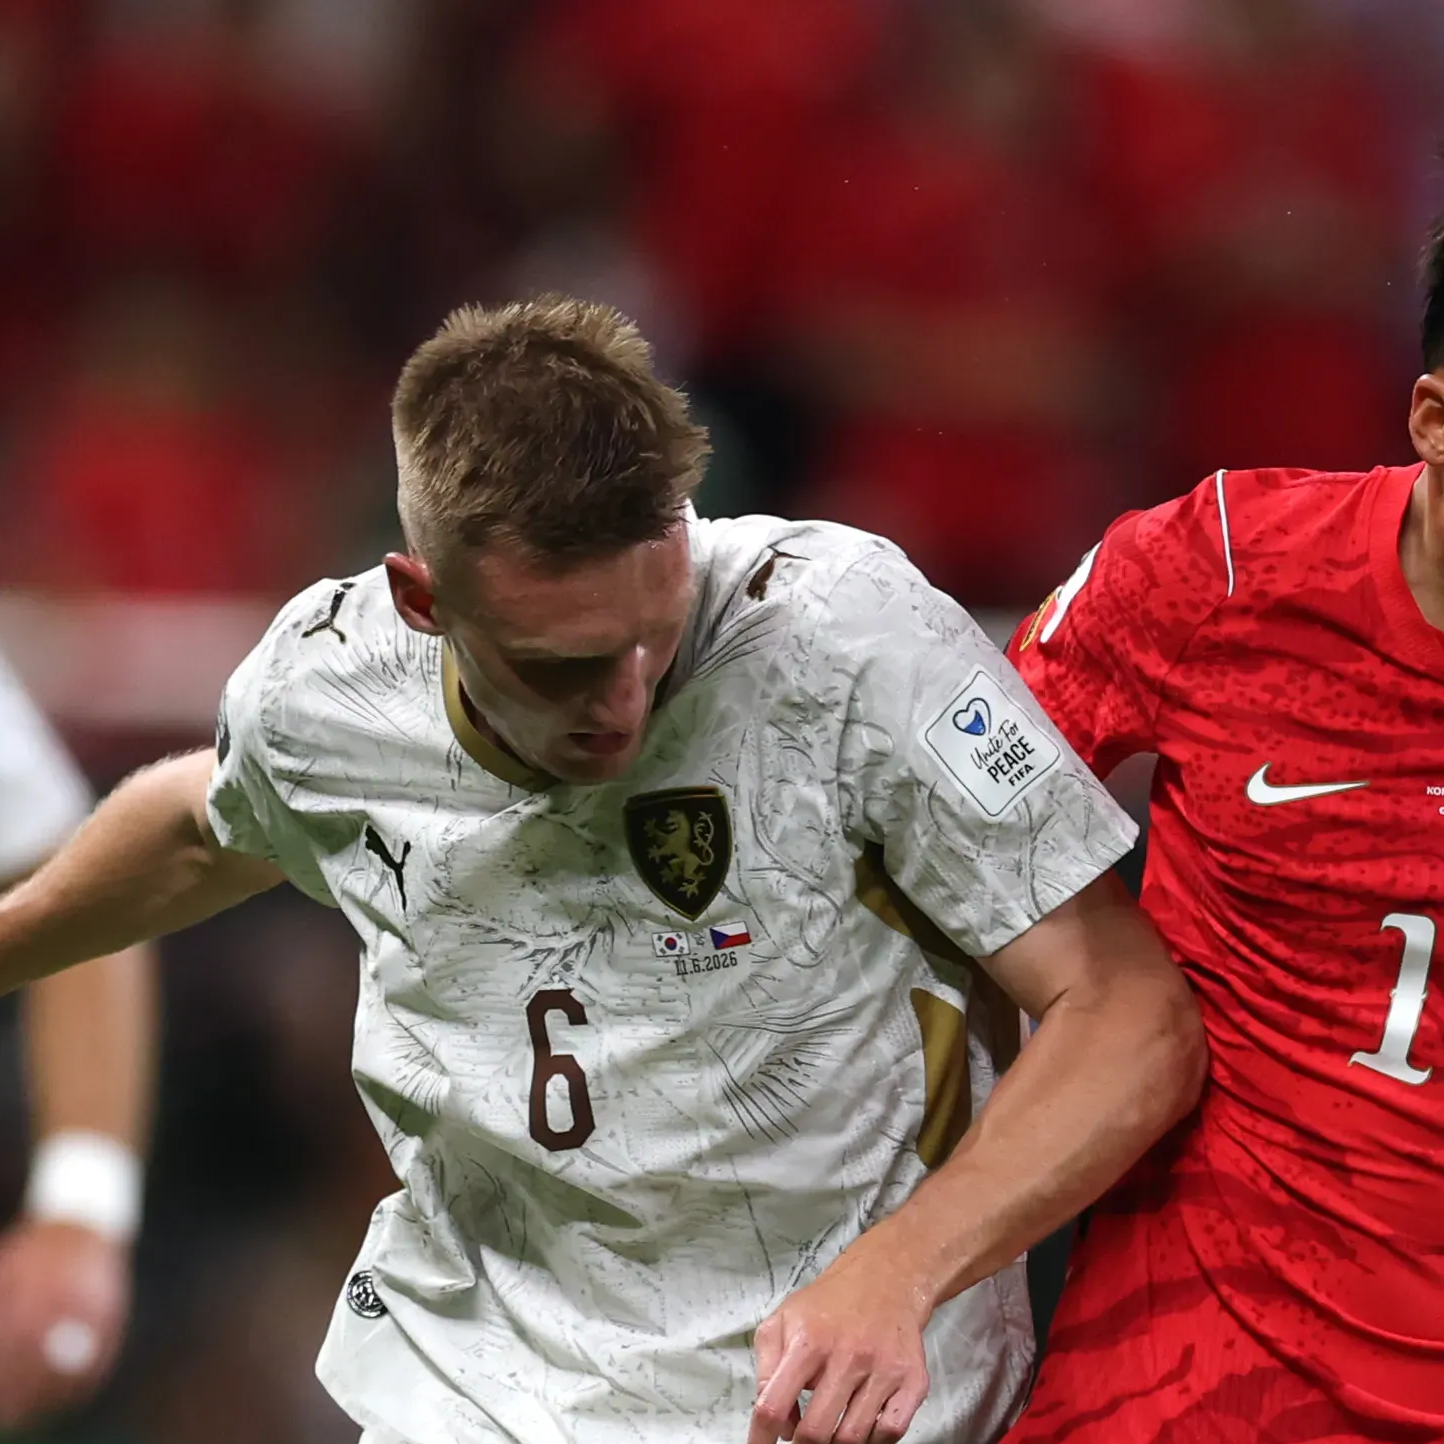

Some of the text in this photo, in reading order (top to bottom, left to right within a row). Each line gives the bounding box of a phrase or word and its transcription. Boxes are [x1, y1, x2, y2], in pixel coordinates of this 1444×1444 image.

[970, 719, 1019, 770] Unite For
[987, 736, 1035, 784] PEACE
[1008, 764, 1034, 786] FIFA
[674, 951, 738, 976] 11.6.2026
[525, 989, 595, 1151] 6
